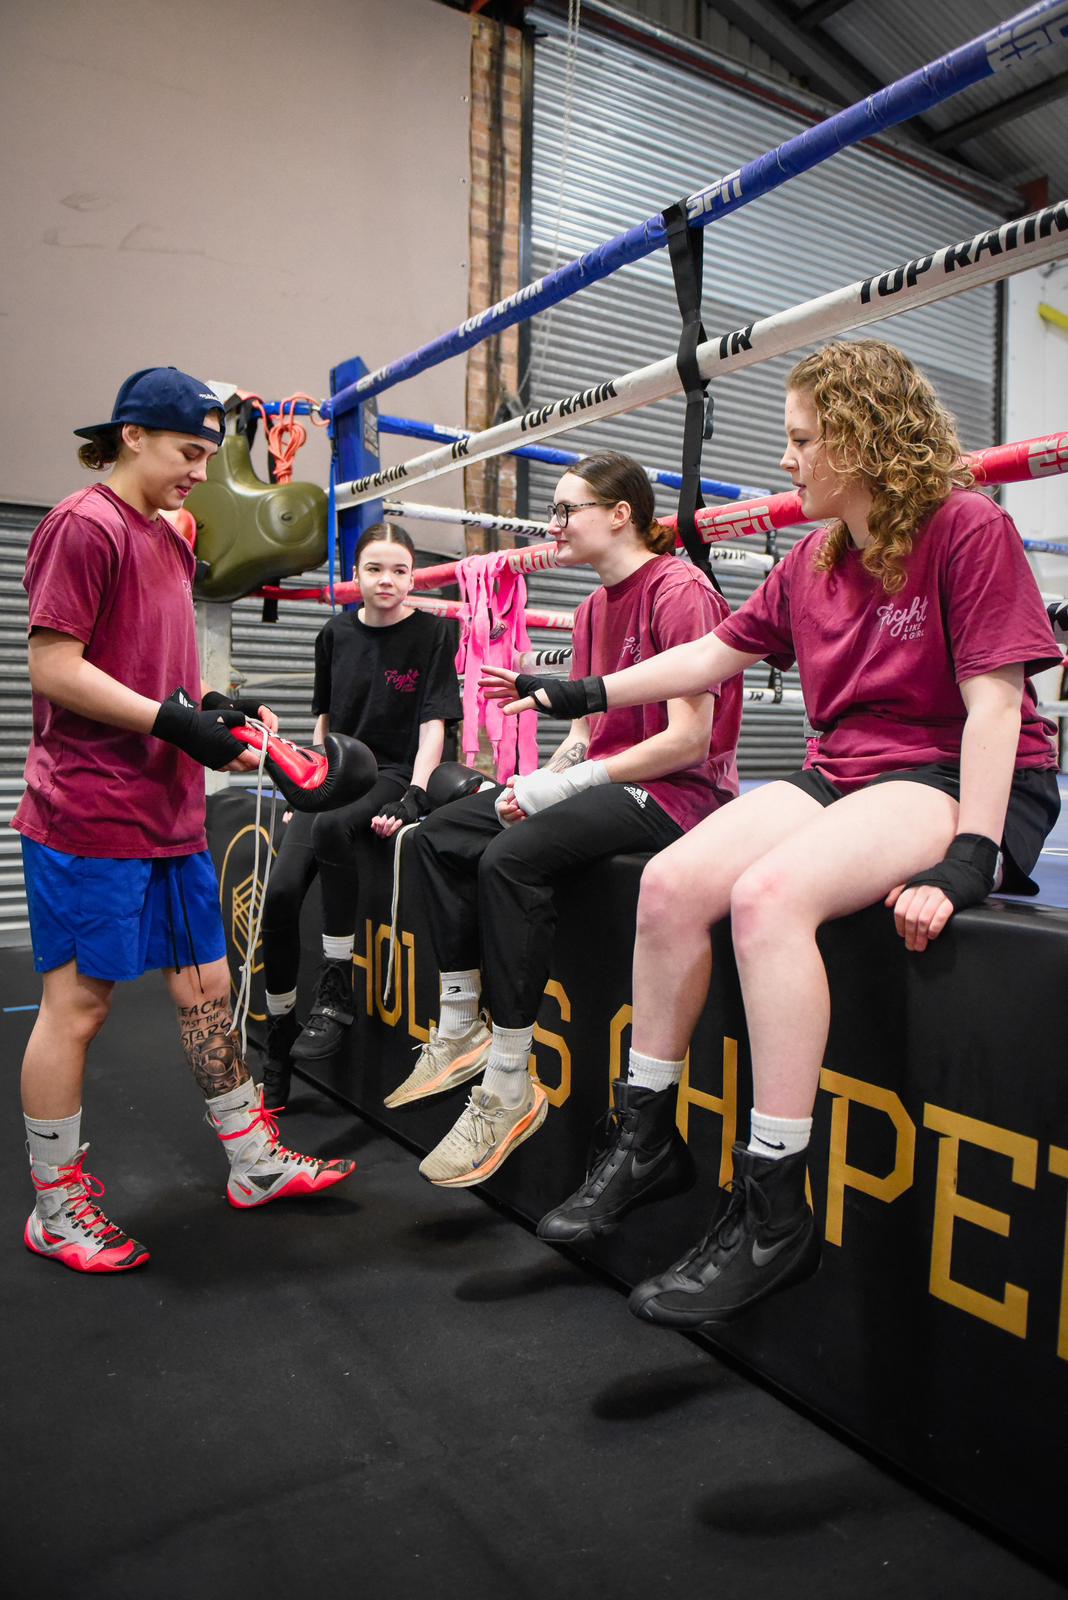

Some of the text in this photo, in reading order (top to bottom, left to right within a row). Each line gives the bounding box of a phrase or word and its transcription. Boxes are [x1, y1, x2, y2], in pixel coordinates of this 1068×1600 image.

[686, 169, 743, 220] SPN
[698, 505, 775, 543] ESPN
[877, 595, 929, 637] Fight
